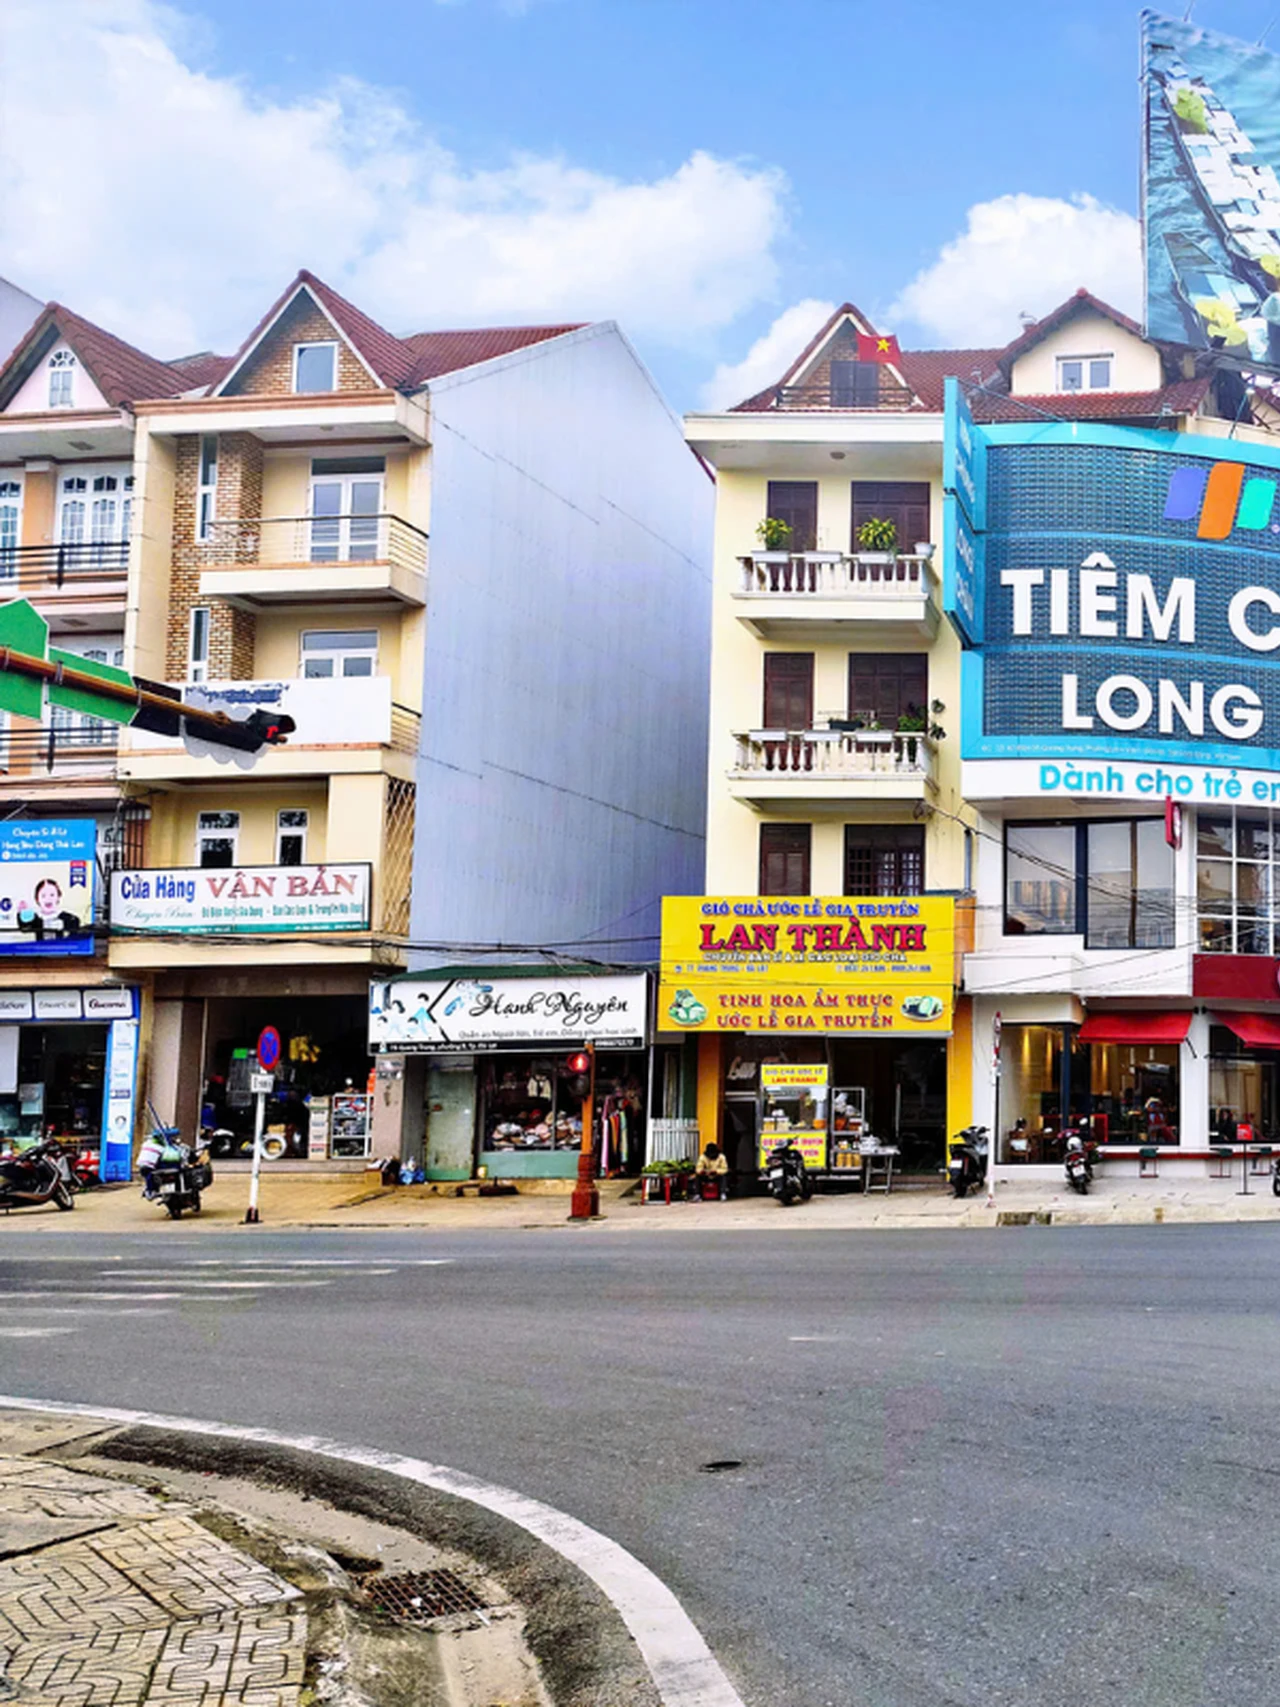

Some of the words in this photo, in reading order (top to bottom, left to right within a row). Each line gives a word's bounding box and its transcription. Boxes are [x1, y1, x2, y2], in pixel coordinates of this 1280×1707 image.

[1000, 551, 1196, 645] TIÊM
[1061, 673, 1265, 742] LONG
[1039, 761, 1125, 793] Dành
[1135, 768, 1194, 795] cho
[1202, 769, 1243, 799] trẻ
[120, 873, 151, 900] Cửa
[155, 874, 197, 903] Hàng
[205, 870, 277, 899] VÂN
[825, 903, 853, 917] GIA
[699, 923, 780, 951] LAN
[786, 915, 927, 951] THÀNH
[468, 992, 547, 1019] Hạnh
[543, 991, 629, 1027] Nguyên
[718, 993, 763, 1007] TINH
[770, 993, 806, 1007] HOA
[784, 1014, 816, 1028] GIA
